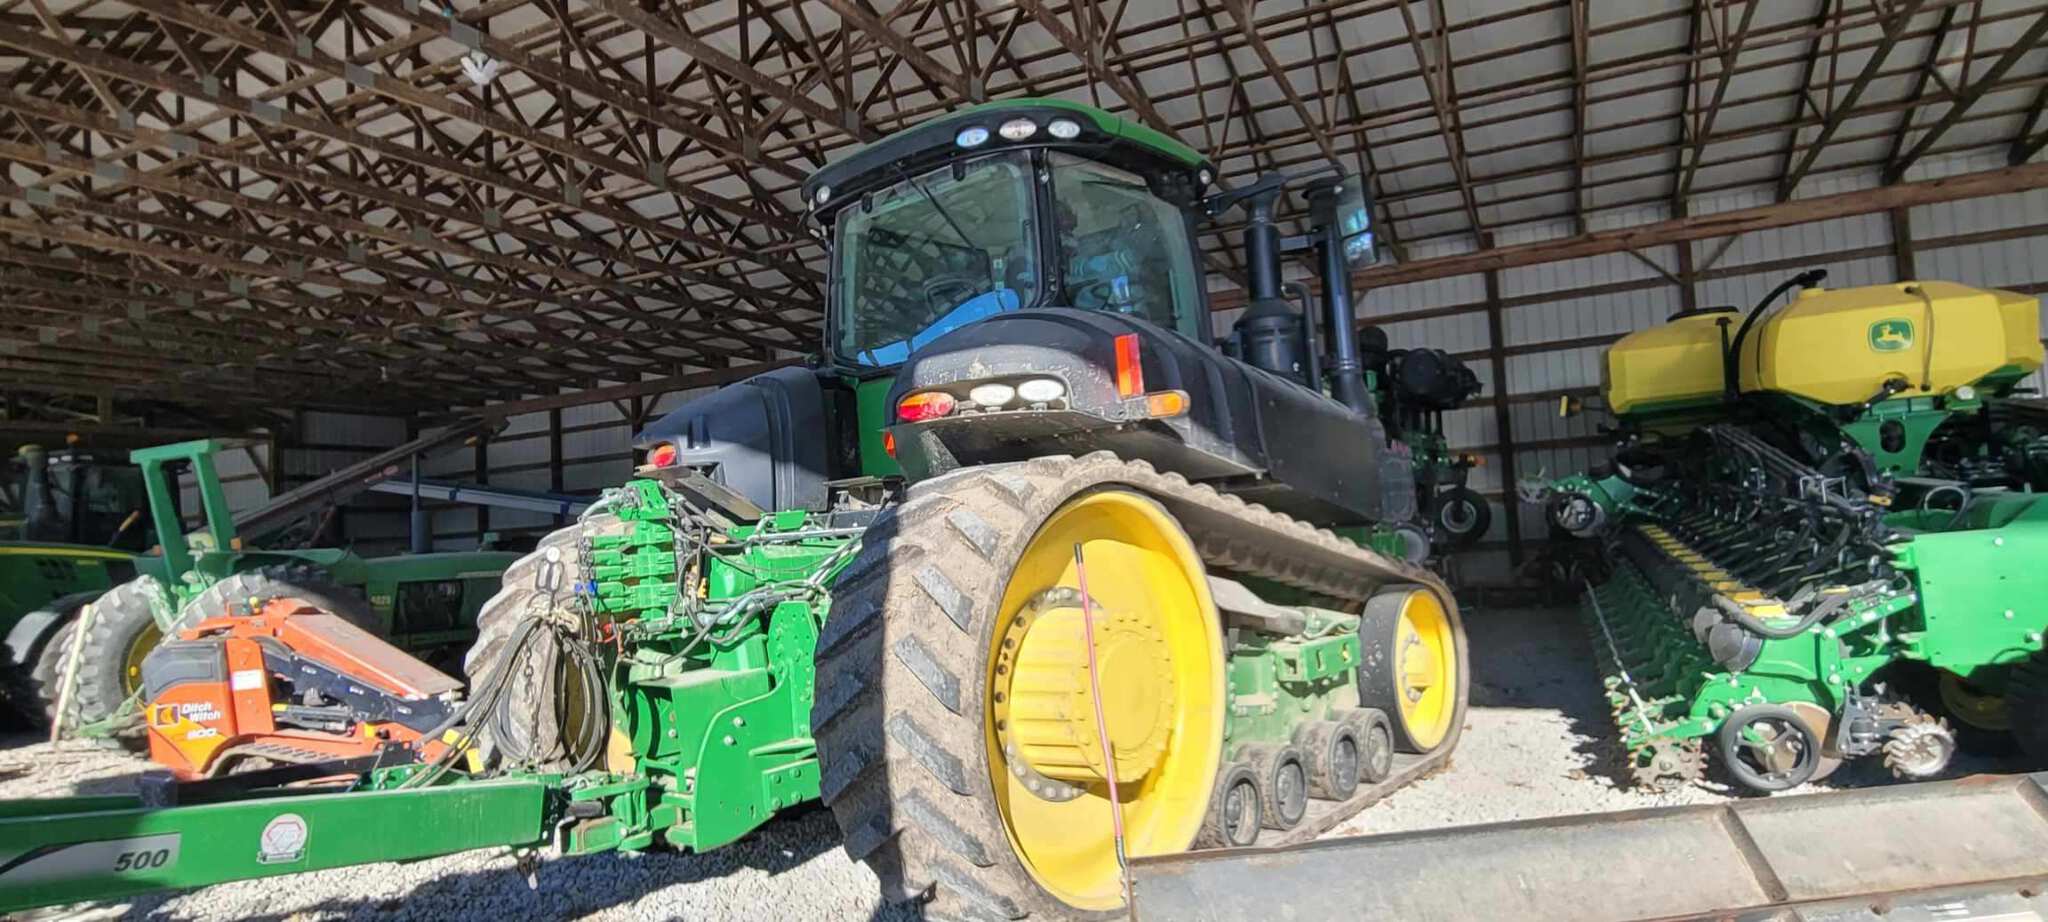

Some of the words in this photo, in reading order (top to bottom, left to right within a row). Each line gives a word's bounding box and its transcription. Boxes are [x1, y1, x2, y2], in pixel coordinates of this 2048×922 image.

[182, 702, 212, 714] Ditch
[189, 710, 222, 723] Witch
[114, 848, 170, 872] 500
